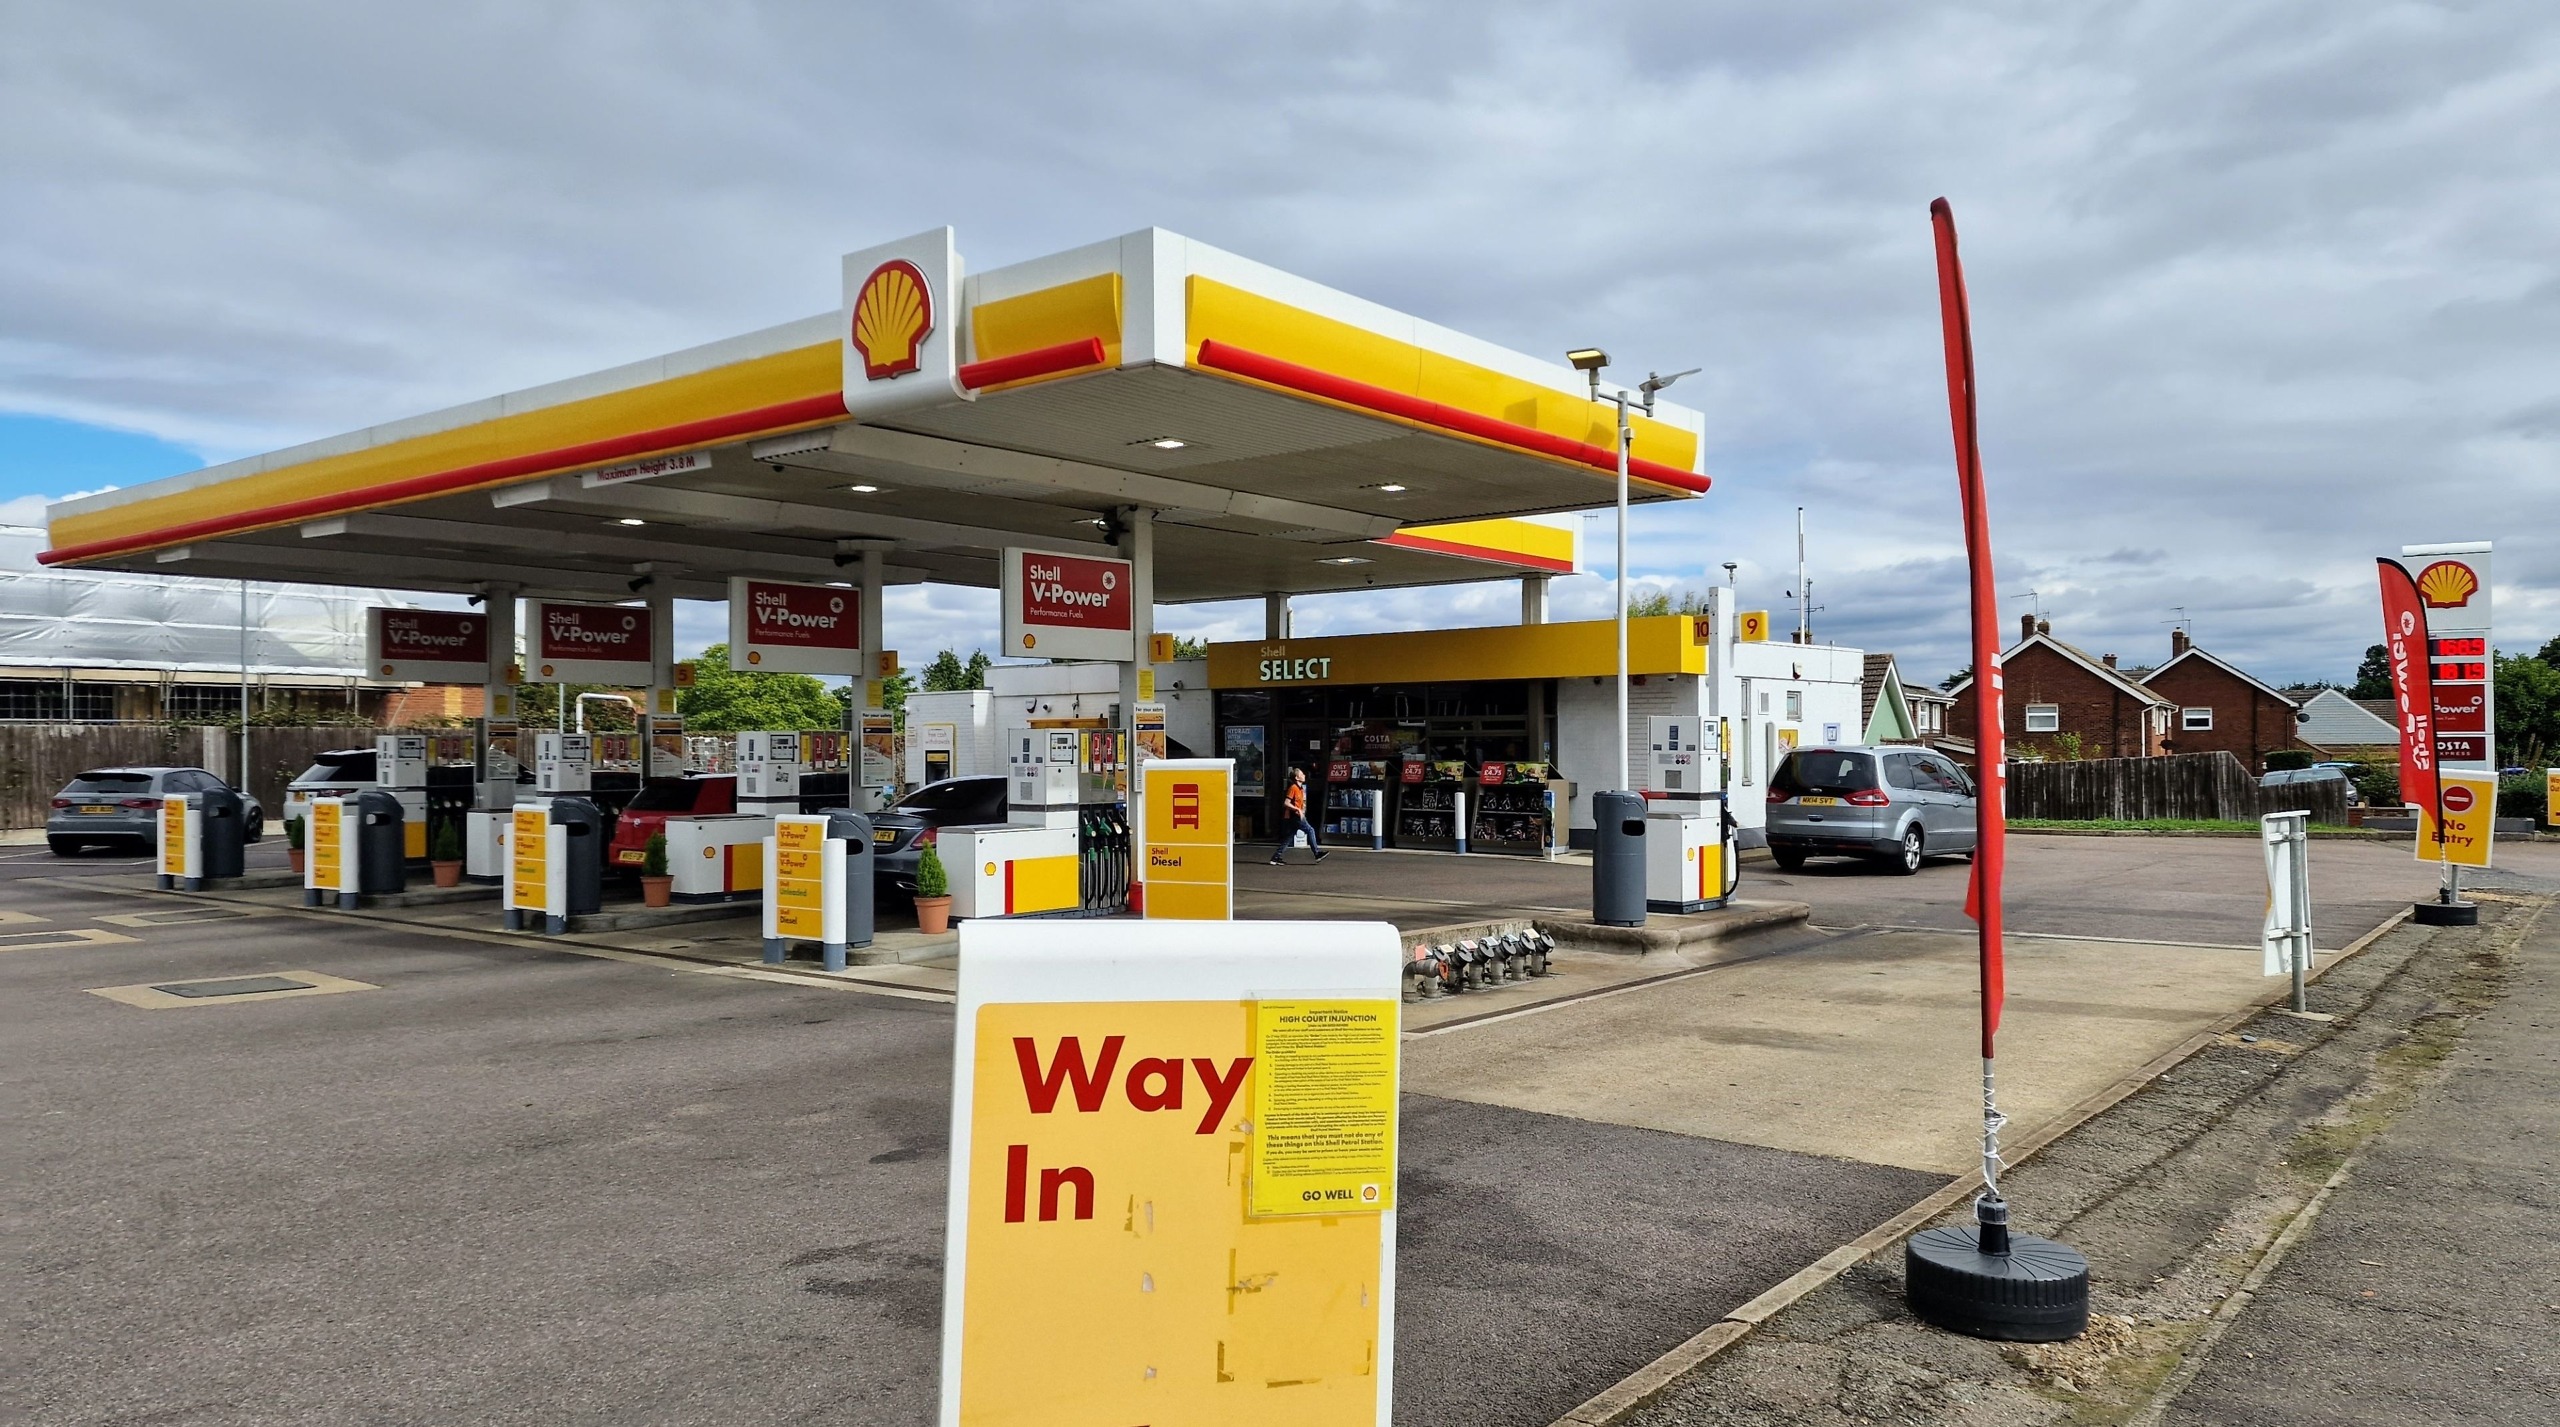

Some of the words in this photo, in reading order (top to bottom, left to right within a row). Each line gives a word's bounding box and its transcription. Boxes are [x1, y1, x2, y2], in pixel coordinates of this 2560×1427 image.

[596, 467, 637, 481] Maximum
[640, 460, 666, 475] Height
[686, 456, 696, 468] M
[1030, 564, 1060, 582] Shell
[755, 592, 786, 606] Shell
[1030, 582, 1110, 608] V-Power
[548, 612, 579, 625] Shell
[756, 606, 838, 628] V-Power
[1030, 607, 1068, 618] Performance
[1069, 610, 1084, 619] Fuels
[388, 618, 418, 629] Shell
[1694, 621, 1709, 638] 10
[1746, 618, 1758, 634] 9
[388, 630, 467, 646] V-Power
[549, 626, 630, 644] V-Power
[755, 628, 794, 638] Performance
[795, 630, 810, 638] Fuels
[1156, 640, 1162, 656] 1
[1261, 645, 1286, 657] Shell
[882, 657, 889, 670] 3
[1260, 658, 1331, 681] SELECT
[678, 670, 687, 681] 5
[2434, 704, 2478, 714] Power
[2437, 742, 2470, 750] OSTA
[2443, 818, 2466, 831] No
[2432, 832, 2474, 847] Entry
[1151, 856, 1182, 866] Diesel
[780, 916, 798, 924] Diesel
[1013, 1036, 1254, 1135] Way
[1004, 1144, 1096, 1224] In
[1302, 1191, 1321, 1201] GO
[1325, 1190, 1354, 1200] WELL
